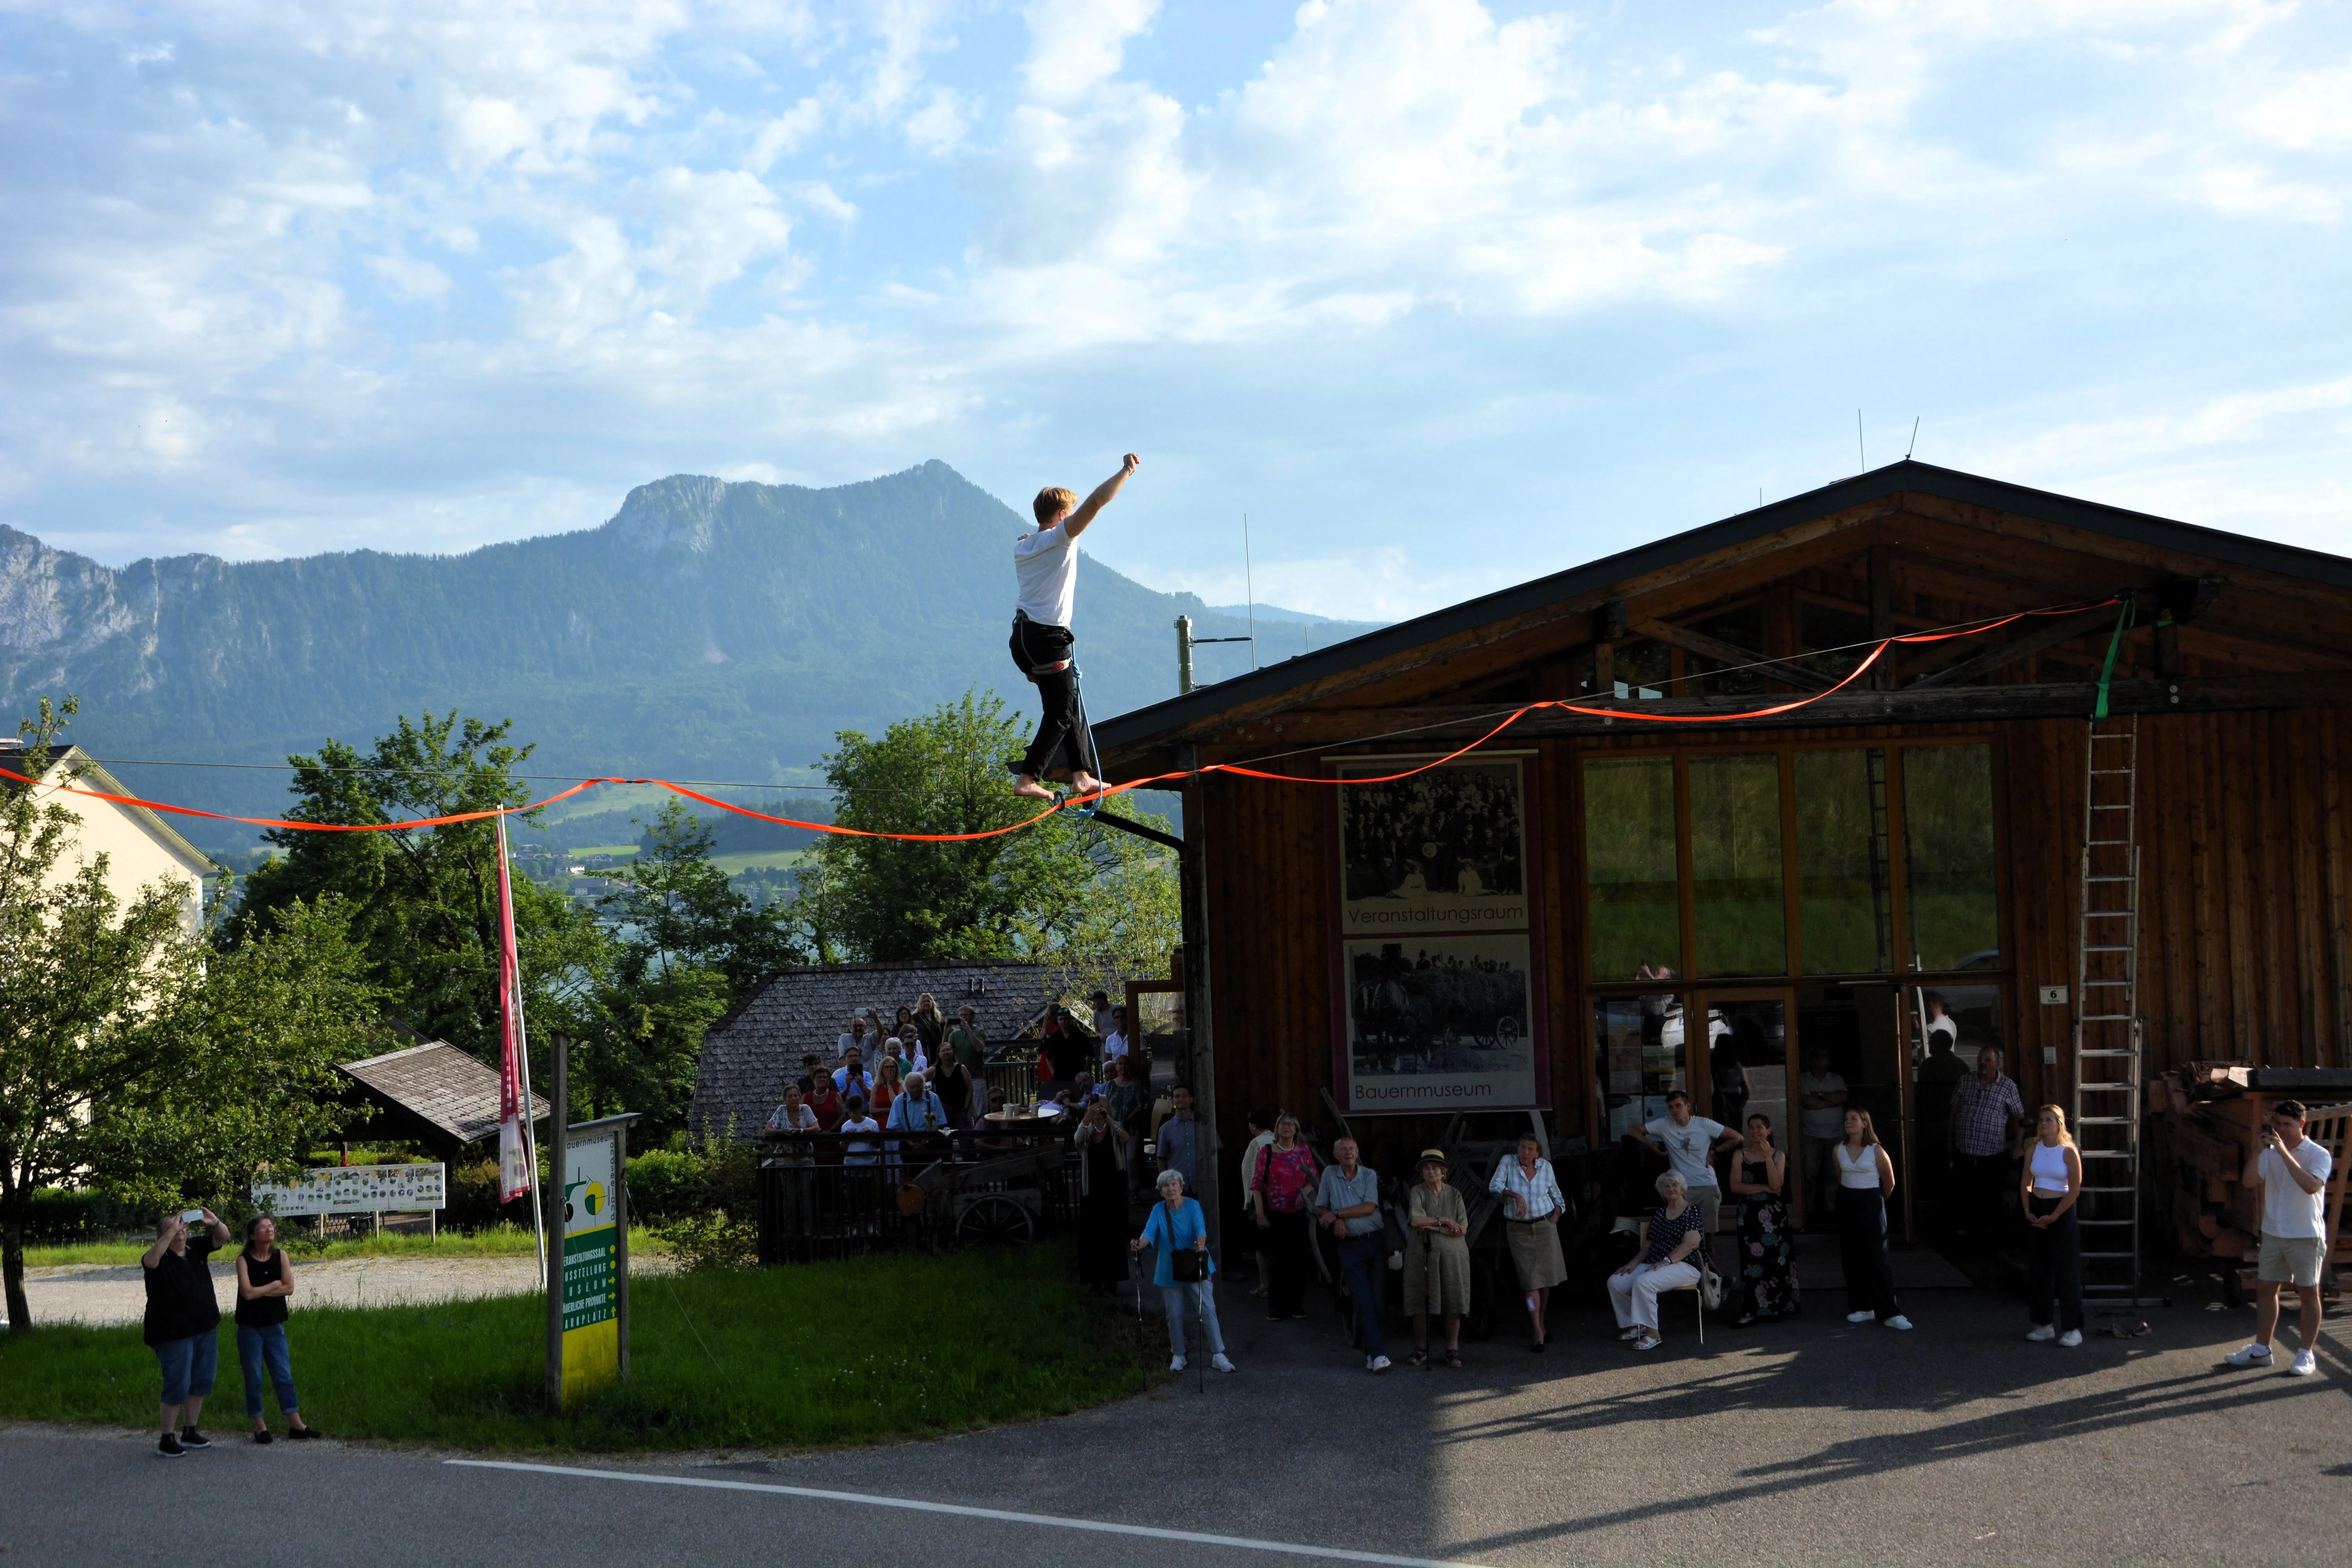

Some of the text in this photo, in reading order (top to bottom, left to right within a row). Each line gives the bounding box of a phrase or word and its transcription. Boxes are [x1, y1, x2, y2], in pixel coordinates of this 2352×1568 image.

[1348, 906, 1523, 924] Veranstaltungsraum
[2050, 990, 2057, 998] 6
[1356, 1084, 1491, 1100] Bauernmuseum
[567, 1134, 613, 1149] auernmuseum
[563, 1247, 606, 1267] ERANSTALTUNGSSAAL
[565, 1262, 606, 1282] USSTELLUNG
[569, 1278, 606, 1296] USEUM
[563, 1293, 606, 1314] ÄUERLICHE PRODUKTE
[565, 1308, 606, 1330] ARKPLATZ
